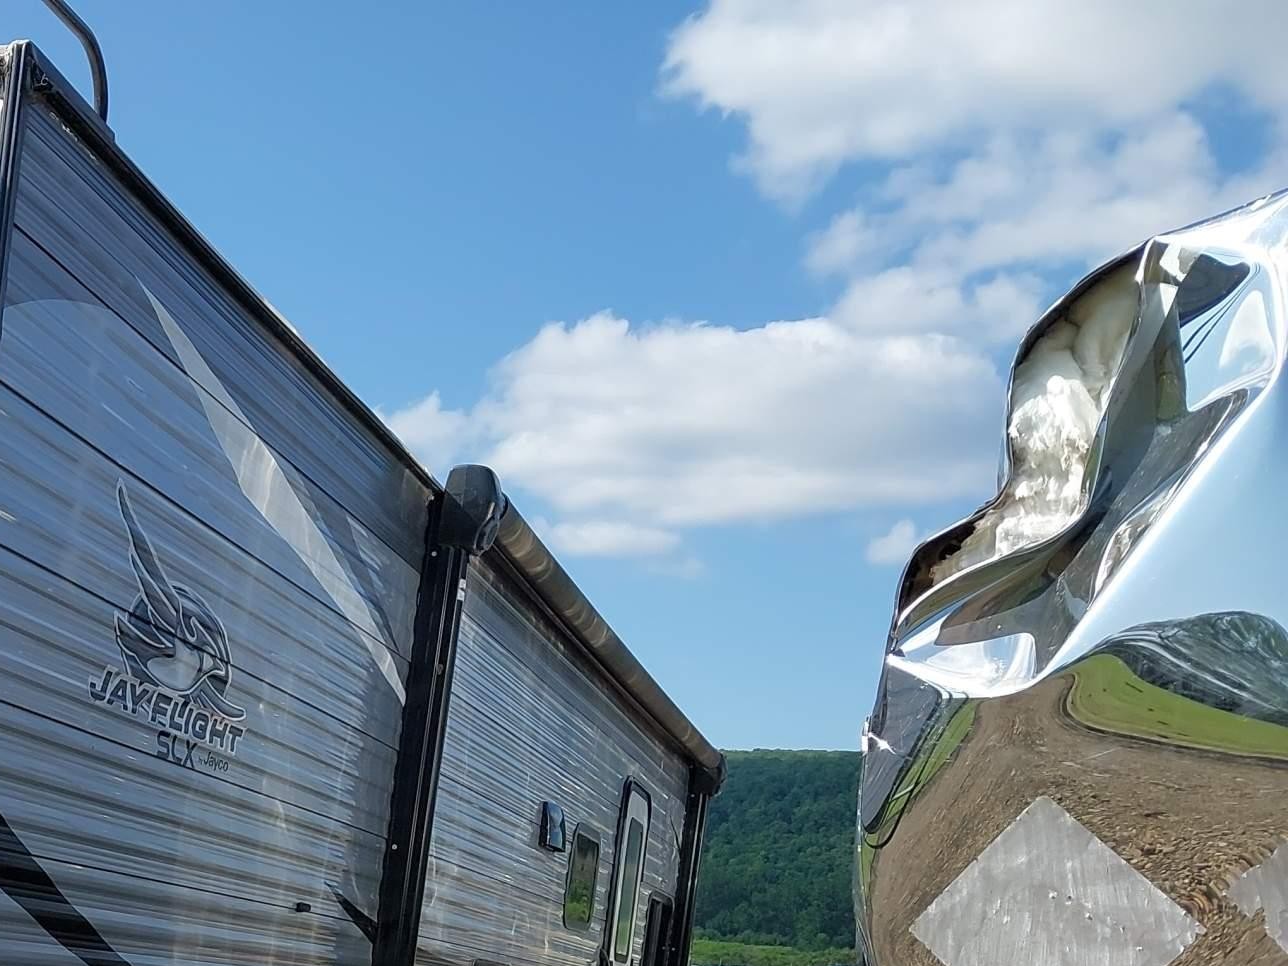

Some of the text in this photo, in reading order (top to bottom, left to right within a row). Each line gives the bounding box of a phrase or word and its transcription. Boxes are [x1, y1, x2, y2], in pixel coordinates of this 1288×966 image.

[88, 664, 246, 754] JAY FLIGHT
[155, 730, 198, 770] SLX
[203, 751, 229, 772] Jayco
